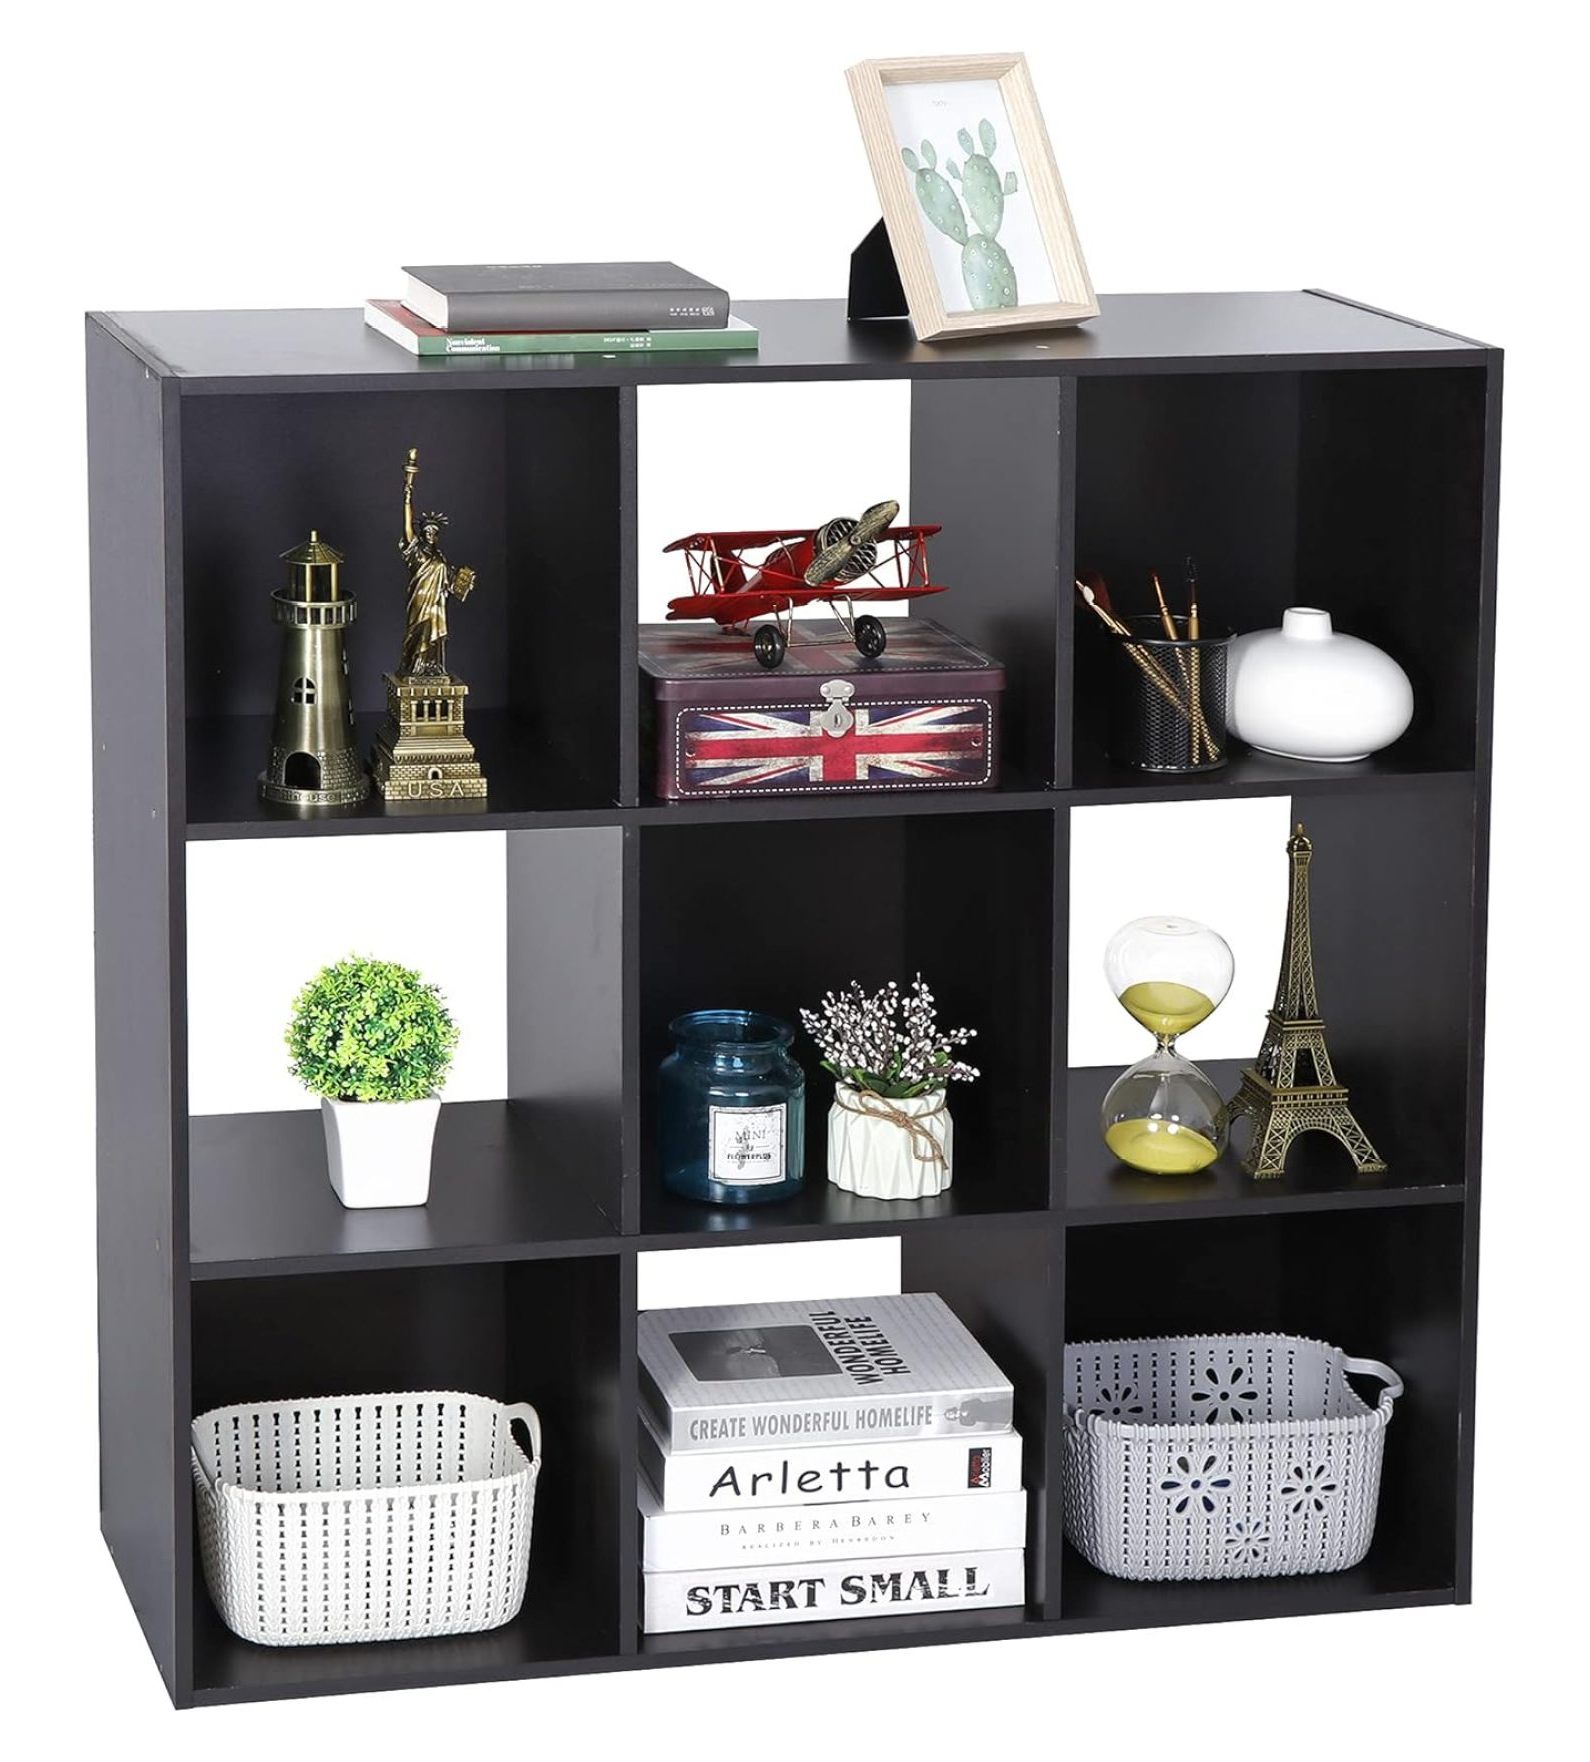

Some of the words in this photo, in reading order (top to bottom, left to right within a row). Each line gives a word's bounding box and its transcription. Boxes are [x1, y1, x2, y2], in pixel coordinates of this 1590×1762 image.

[808, 1311, 883, 1385] WONDERFUL
[844, 1316, 911, 1374] HOMELIFE
[690, 1417, 746, 1441] CREATE
[752, 1409, 849, 1436] WONDERFUL
[855, 1405, 933, 1429] HOMELIFE
[709, 1460, 910, 1497] Arletta
[720, 1518, 839, 1536] BARBERA
[851, 1512, 931, 1528] BAREY
[686, 1578, 826, 1617] START
[840, 1567, 991, 1606] SMALL
